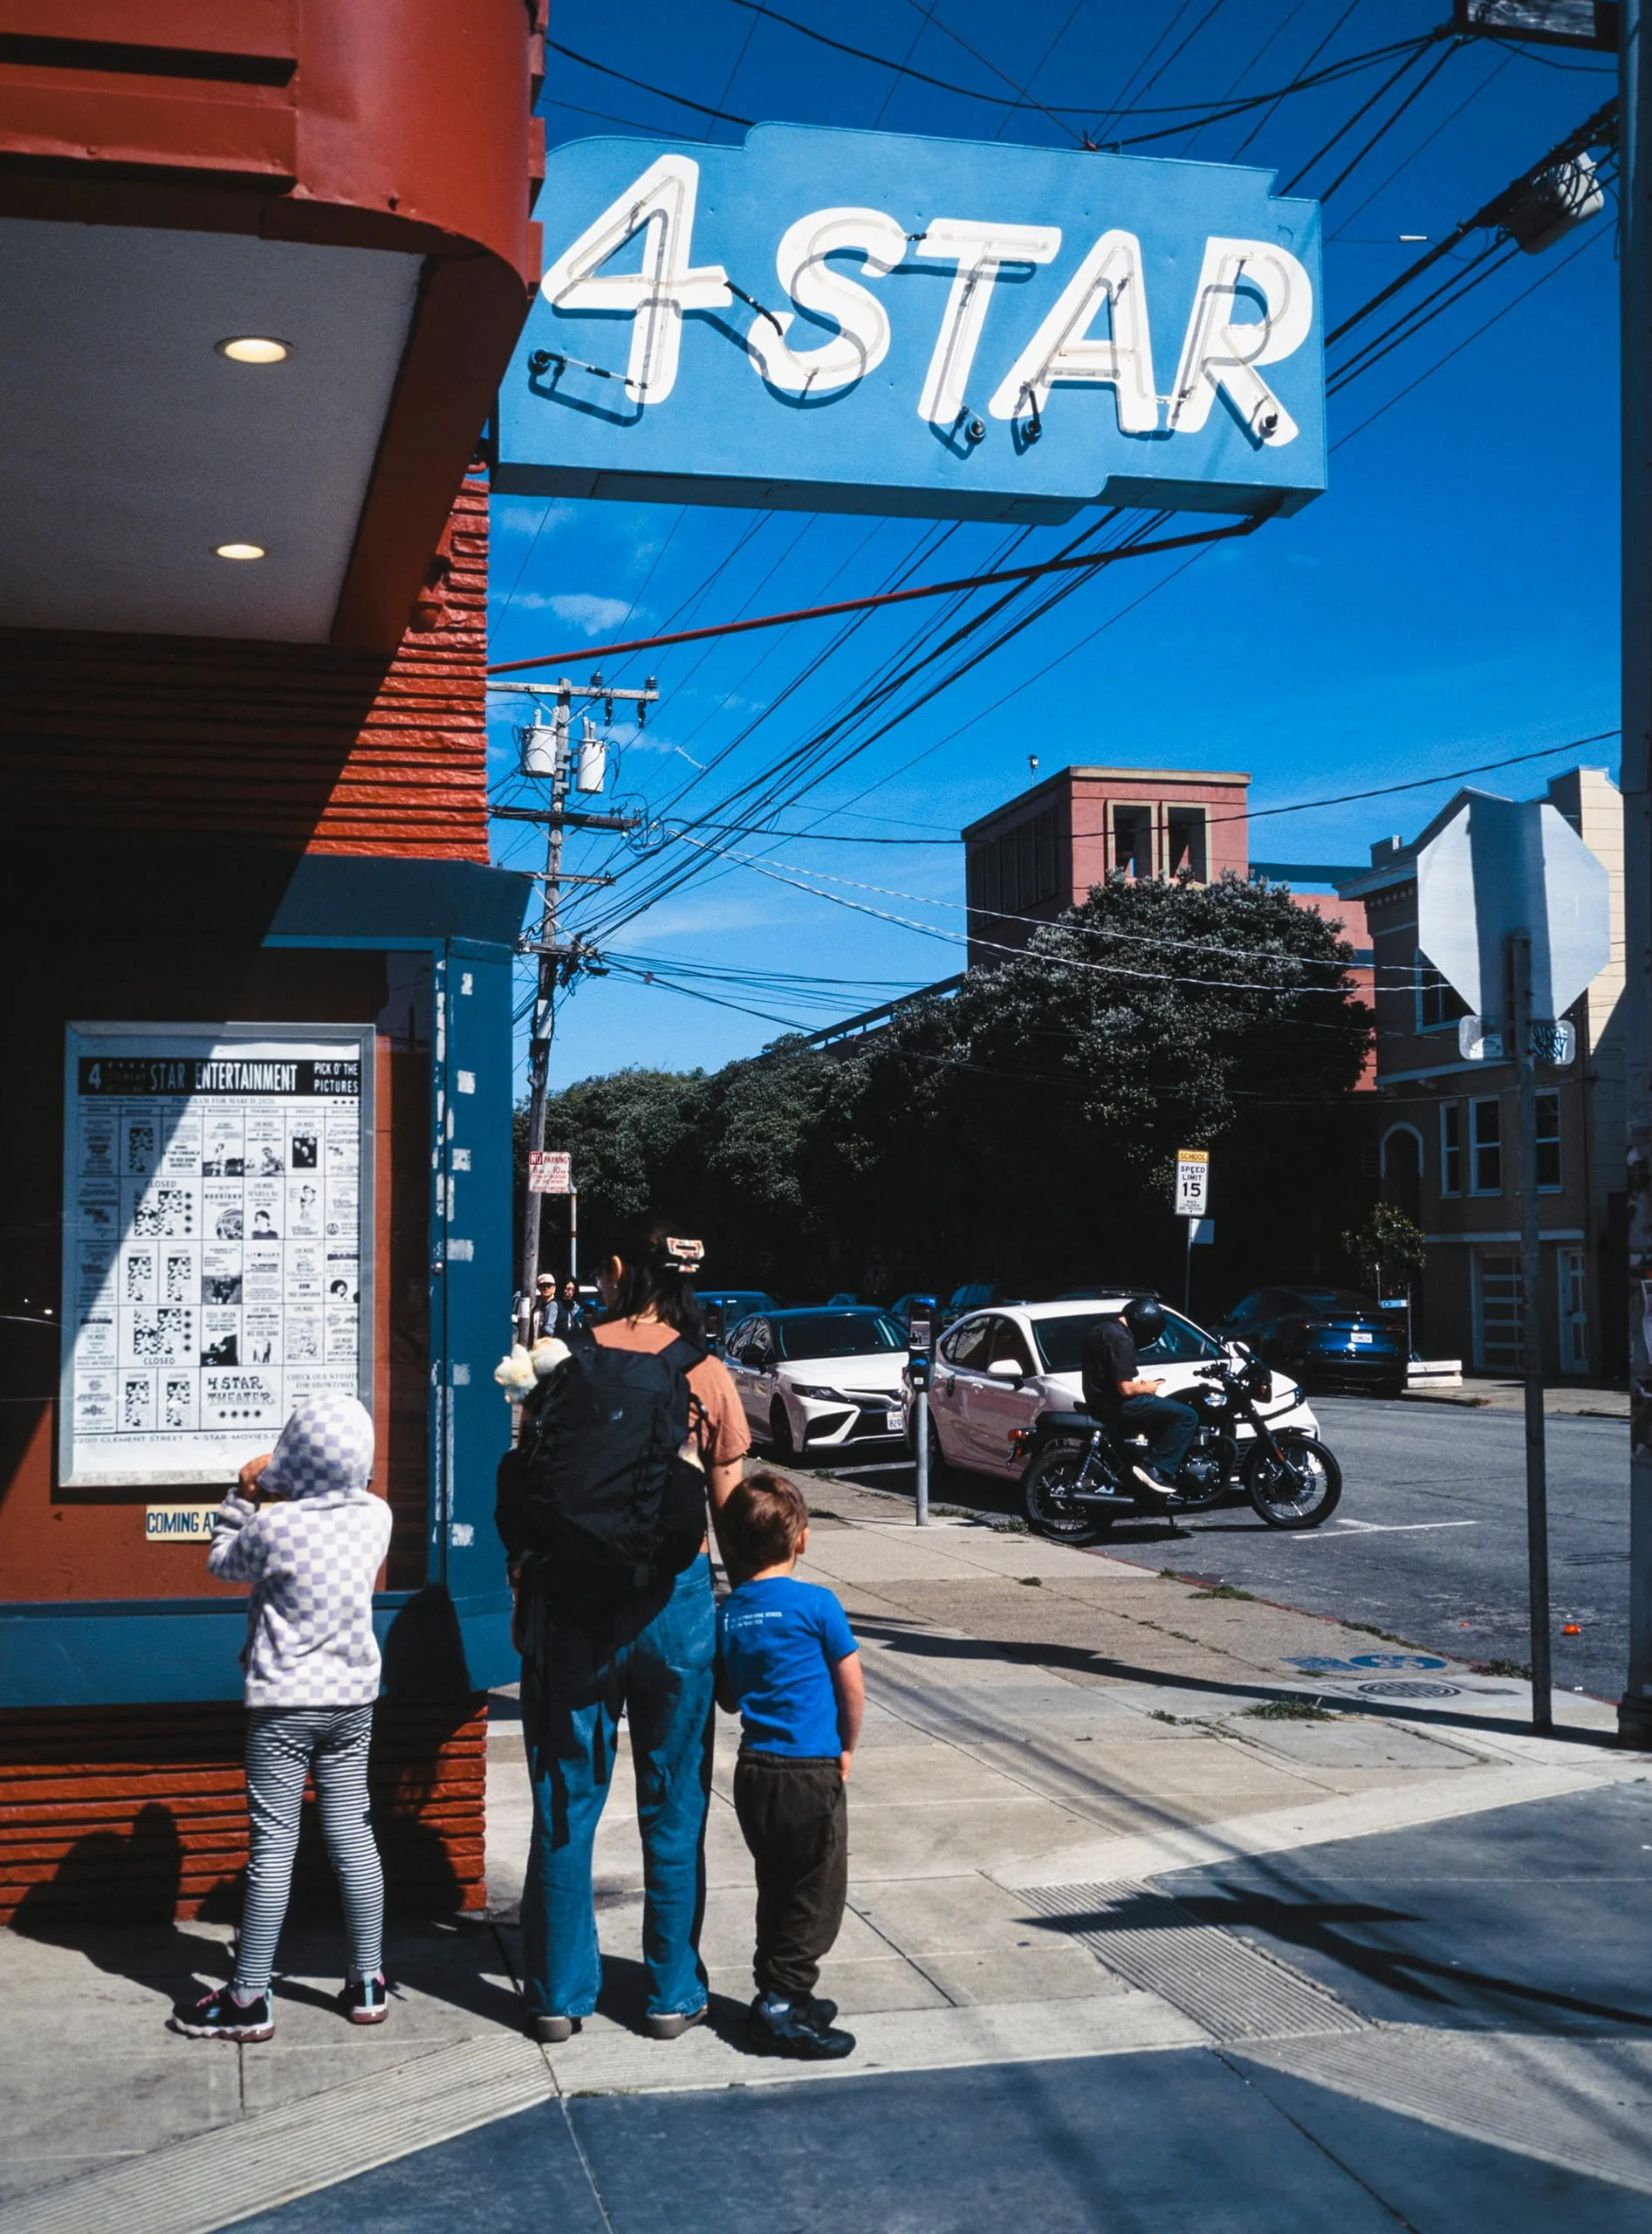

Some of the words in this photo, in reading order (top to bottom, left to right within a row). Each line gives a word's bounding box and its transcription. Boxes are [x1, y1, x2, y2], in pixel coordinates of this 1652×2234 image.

[541, 154, 732, 405] 4
[749, 207, 1314, 448] STAR
[313, 1062, 332, 1075] PICK
[344, 1063, 359, 1076] THE
[88, 1062, 101, 1090] 4
[150, 1062, 186, 1090] STAR
[195, 1062, 298, 1091] ENTERTAINMENT
[313, 1079, 359, 1093] PICTURES
[531, 1153, 542, 1164] NO
[1180, 1152, 1206, 1161] SCHOOL
[145, 1180, 177, 1189] CLOSED
[1182, 1182, 1201, 1197] 15
[207, 1377, 218, 1390] 4
[221, 1375, 264, 1390] STAR
[207, 1392, 273, 1406] THEATER
[147, 1511, 200, 1533] COMING
